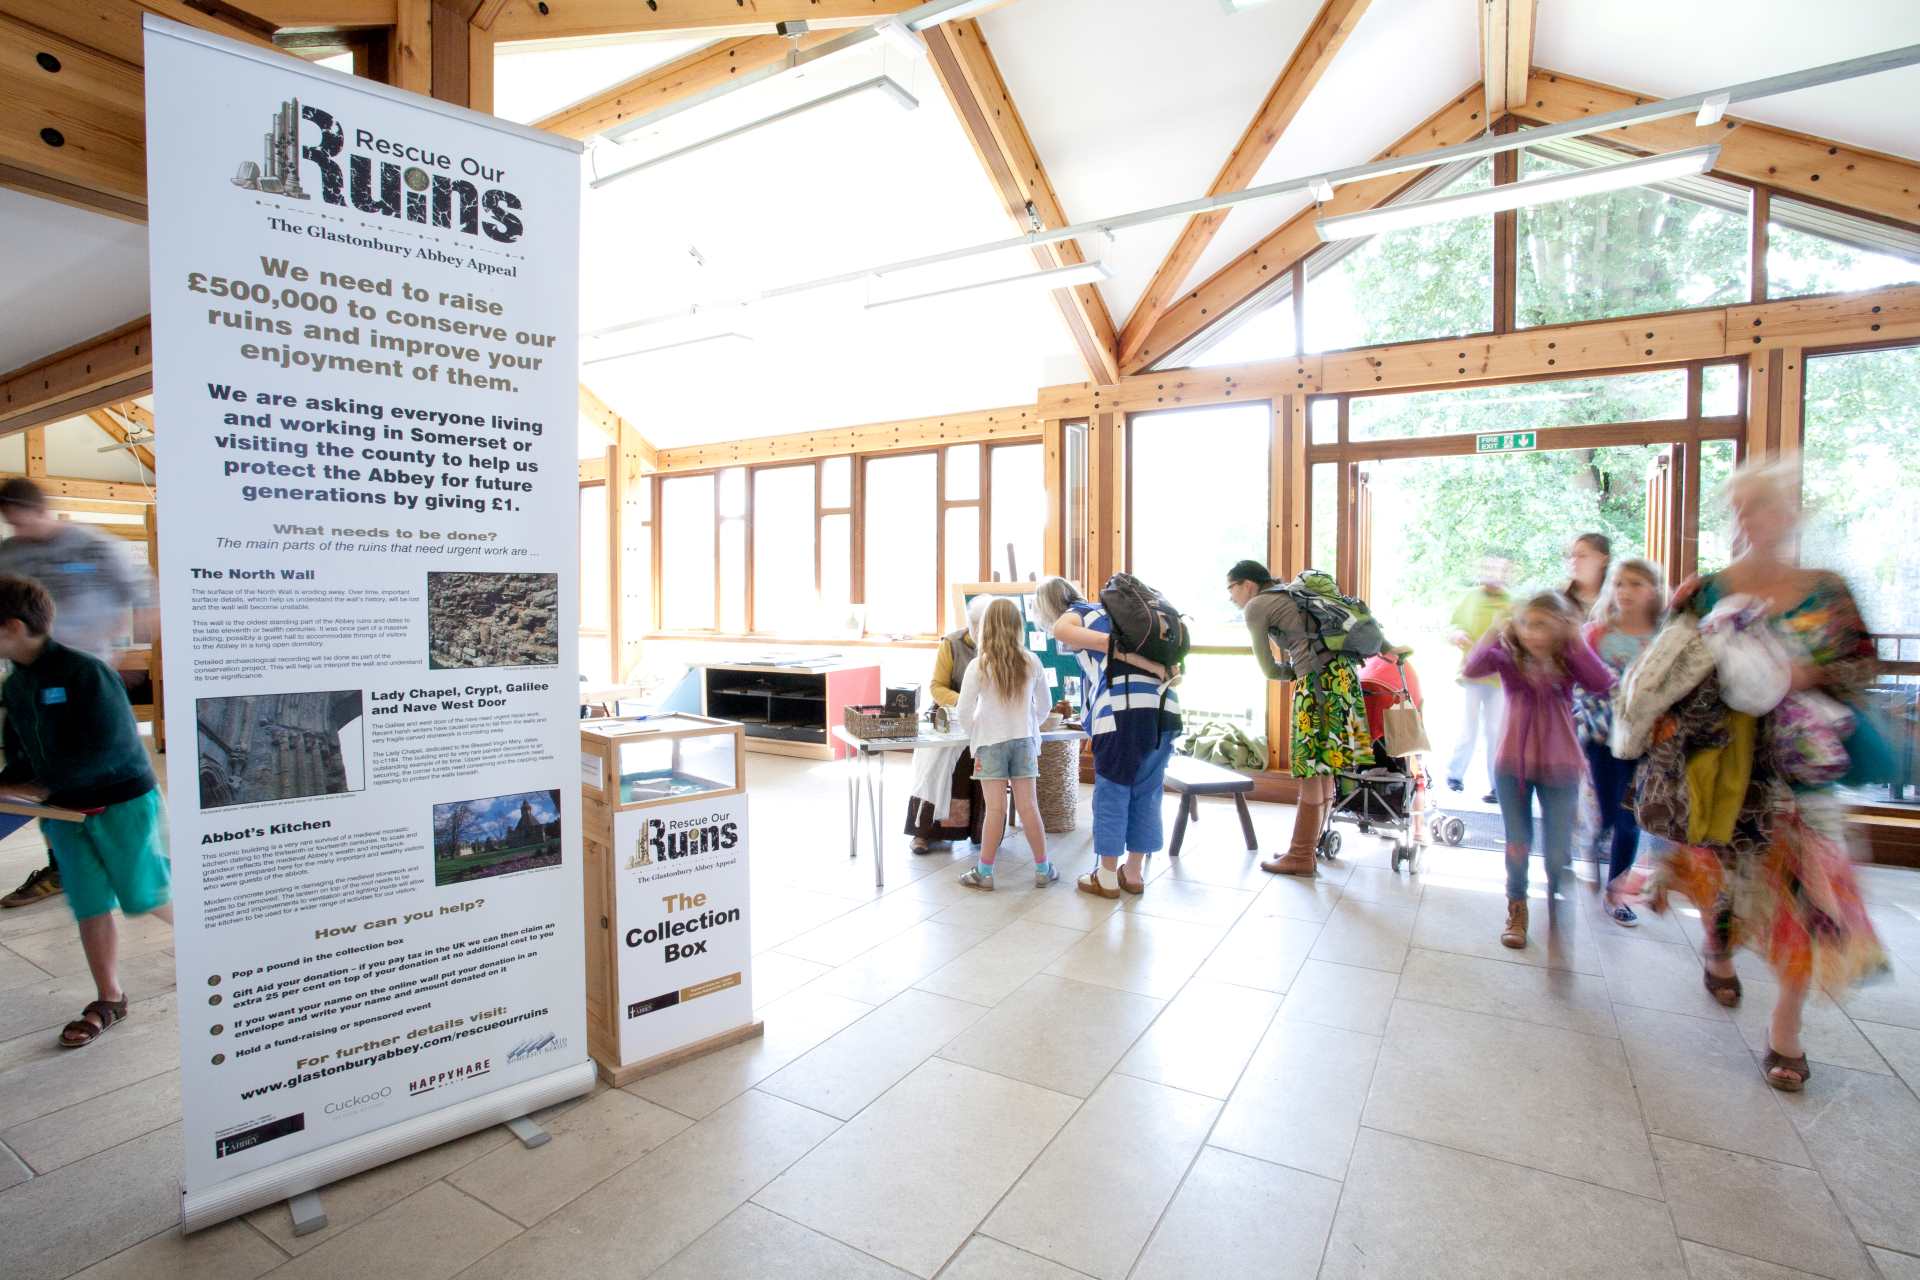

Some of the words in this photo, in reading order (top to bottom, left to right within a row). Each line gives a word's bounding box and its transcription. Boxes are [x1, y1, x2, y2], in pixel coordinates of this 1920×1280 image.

[301, 105, 523, 244] Ruins
[356, 128, 451, 170] Rescue
[460, 157, 505, 183] Our
[267, 216, 303, 235] The
[306, 225, 412, 258] Glastonbury
[415, 247, 464, 268] Abbey
[466, 257, 516, 277] Appeal
[259, 255, 309, 282] We
[319, 270, 392, 297] need
[401, 282, 429, 303] to
[438, 292, 503, 316] raise
[187, 272, 338, 314] £500,000
[346, 299, 376, 321] to
[385, 309, 507, 342] conserve
[515, 331, 556, 348] our
[208, 309, 292, 336] ruins
[303, 324, 360, 345] and
[370, 328, 480, 362] improve
[487, 351, 543, 371] your
[240, 343, 403, 378] enjoyment
[412, 363, 439, 382] of
[446, 367, 518, 393] them.
[207, 382, 247, 402] We
[256, 392, 297, 407] are
[305, 397, 383, 420] asking
[390, 407, 486, 427] everyone
[491, 415, 543, 436] living
[223, 412, 271, 428] and
[279, 418, 376, 441] working
[383, 424, 403, 440] in
[410, 427, 507, 450] Somerset
[512, 440, 533, 452] or
[214, 433, 308, 458] visiting
[315, 441, 354, 458] the
[361, 448, 436, 468] county
[441, 452, 462, 467] to
[468, 453, 510, 474] help
[516, 461, 538, 473] us
[224, 460, 316, 478] protect
[323, 464, 361, 481] the
[367, 467, 435, 489] Abbey
[440, 472, 469, 488] for
[474, 475, 533, 492] future
[241, 485, 386, 504] generations
[393, 490, 419, 509] by
[424, 493, 485, 513] giving
[491, 497, 520, 511] £1.
[216, 537, 242, 549] The
[245, 538, 279, 549] main
[282, 540, 317, 552] parts
[319, 540, 333, 551] of
[335, 540, 354, 552] the
[357, 542, 389, 552] ruins
[390, 543, 412, 553] that
[414, 543, 445, 554] need
[446, 545, 482, 558] urgent
[483, 544, 509, 556] work
[510, 548, 528, 556] are
[273, 523, 324, 536] What
[331, 527, 390, 538] needs
[395, 528, 413, 539] to
[419, 529, 441, 540] be
[446, 530, 497, 542] done?
[190, 568, 223, 579] The
[228, 568, 275, 579] North
[280, 569, 315, 580] Wall
[371, 690, 405, 702] Lady
[409, 686, 461, 700] Chapel,
[464, 684, 502, 697] Crypt,
[505, 682, 549, 693] Galilee
[371, 704, 398, 715] and
[402, 703, 437, 713] Nave
[441, 699, 474, 710] West
[477, 698, 507, 708] Door
[270, 820, 331, 835] Kitchen
[649, 819, 738, 862] Ruins
[669, 817, 708, 830] Rescue
[711, 813, 730, 822] Our
[638, 876, 650, 884] The
[651, 868, 693, 881] Glastonbury
[693, 863, 714, 873] Abbey
[715, 858, 737, 869] Appeal
[314, 924, 357, 940] How
[363, 917, 397, 930] can
[403, 910, 433, 925] you
[439, 898, 485, 915] help?
[662, 893, 706, 913] The
[625, 908, 740, 948] Collection
[231, 969, 253, 979] Pop
[266, 957, 300, 973] pound
[302, 956, 313, 964] in
[315, 953, 333, 961] the
[335, 942, 384, 957] collection
[386, 938, 404, 946] box
[232, 988, 253, 999] Gift
[255, 982, 274, 993] Aid
[276, 978, 301, 990] your
[303, 968, 349, 983] donation
[358, 962, 366, 970] if
[367, 960, 386, 969] you
[387, 955, 405, 965] pay
[407, 952, 422, 960] tax
[435, 946, 450, 954] the
[452, 941, 466, 950] UK
[482, 935, 499, 943] can
[500, 930, 519, 939] then
[520, 925, 543, 934] claim
[544, 922, 555, 930] an
[664, 940, 707, 963] Box
[234, 1019, 242, 1028] If
[245, 1015, 265, 1027] you
[267, 1007, 295, 1019] want
[297, 1002, 321, 1014] your
[323, 995, 353, 1006] name
[354, 991, 367, 999] on
[369, 987, 386, 996] the
[388, 980, 417, 991] online
[419, 973, 439, 984] wall
[440, 969, 456, 980] put
[458, 965, 477, 977] your
[479, 956, 516, 970] donation
[234, 1020, 285, 1038] envelope
[287, 1013, 308, 1025] and
[310, 1008, 337, 1019] write
[339, 1001, 362, 1014] your
[364, 995, 392, 1006] name
[394, 988, 412, 999] and
[414, 980, 448, 994] amount
[450, 970, 486, 985] donated
[235, 1044, 261, 1058] Hold
[273, 1026, 338, 1047] fund-raising
[353, 1008, 404, 1027] sponsored
[405, 1001, 431, 1014] event
[296, 1054, 330, 1070] For
[335, 1035, 400, 1059] further
[406, 1018, 464, 1040] details
[469, 1006, 507, 1022] visit:
[240, 1007, 548, 1100] www.glastonburyabbey.com/rescueourruins
[409, 1058, 490, 1092] HAPPYHARE
